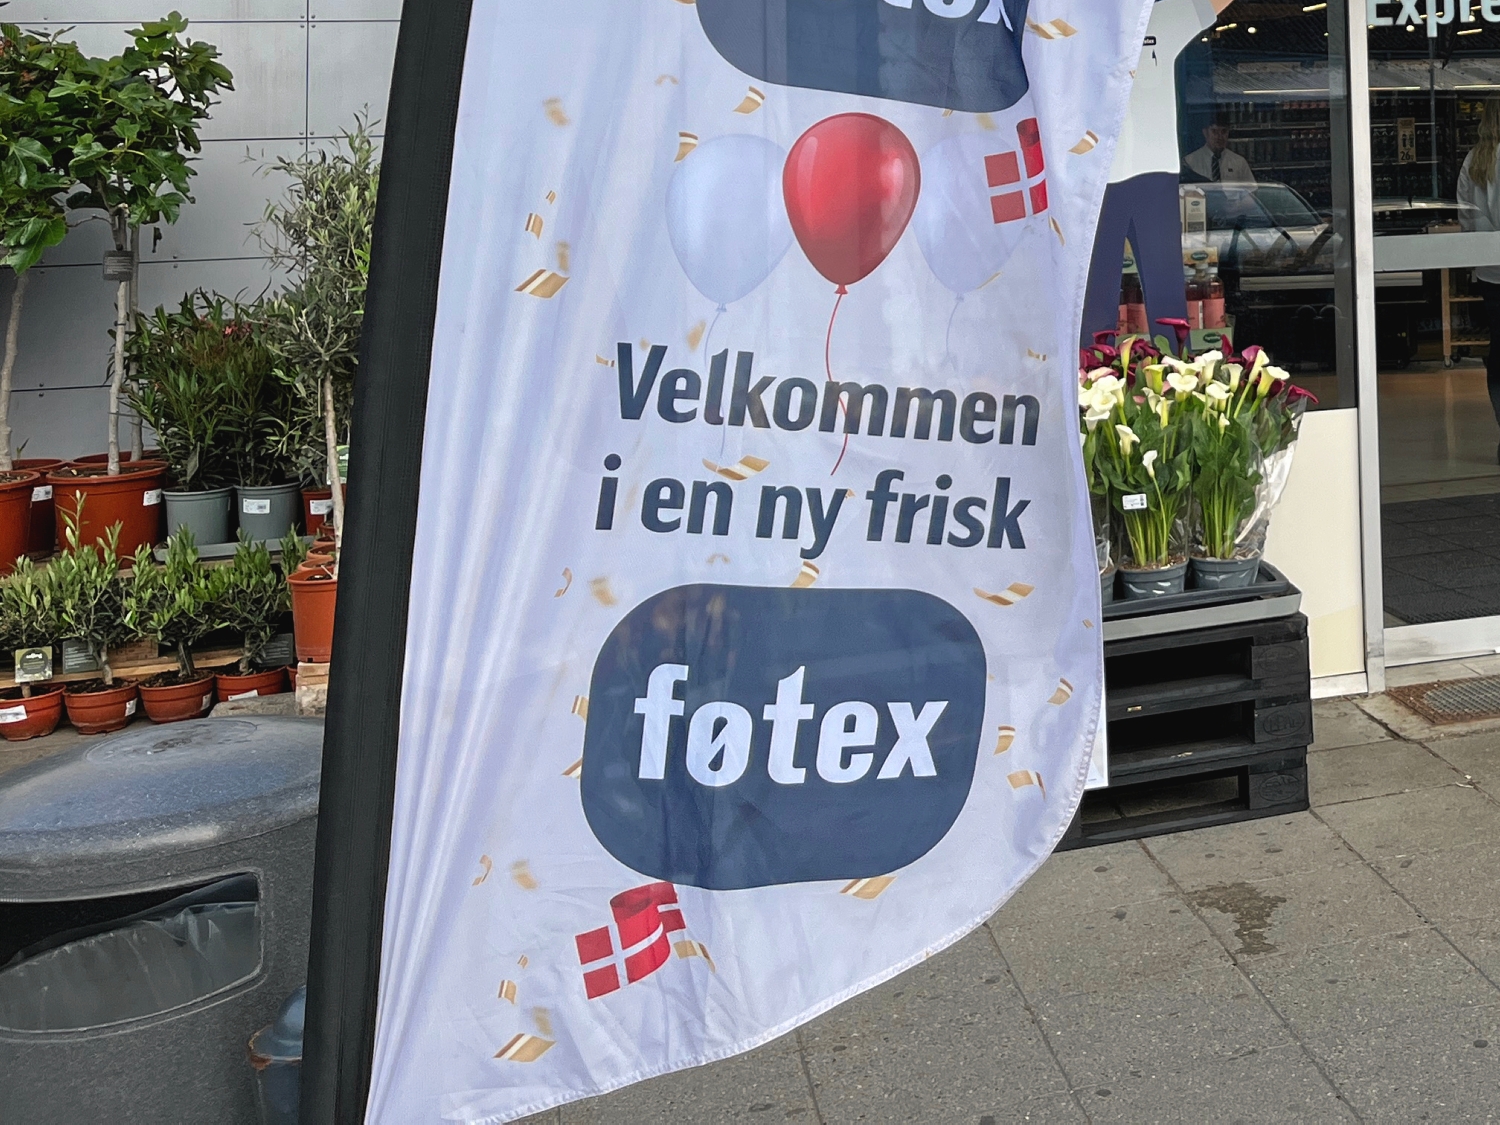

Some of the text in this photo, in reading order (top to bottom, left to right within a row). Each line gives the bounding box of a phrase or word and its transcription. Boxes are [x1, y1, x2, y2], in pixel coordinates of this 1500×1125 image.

[616, 341, 1041, 446] Velkommen
[595, 453, 1032, 560] i en ny frisk
[634, 662, 949, 787] føtex
